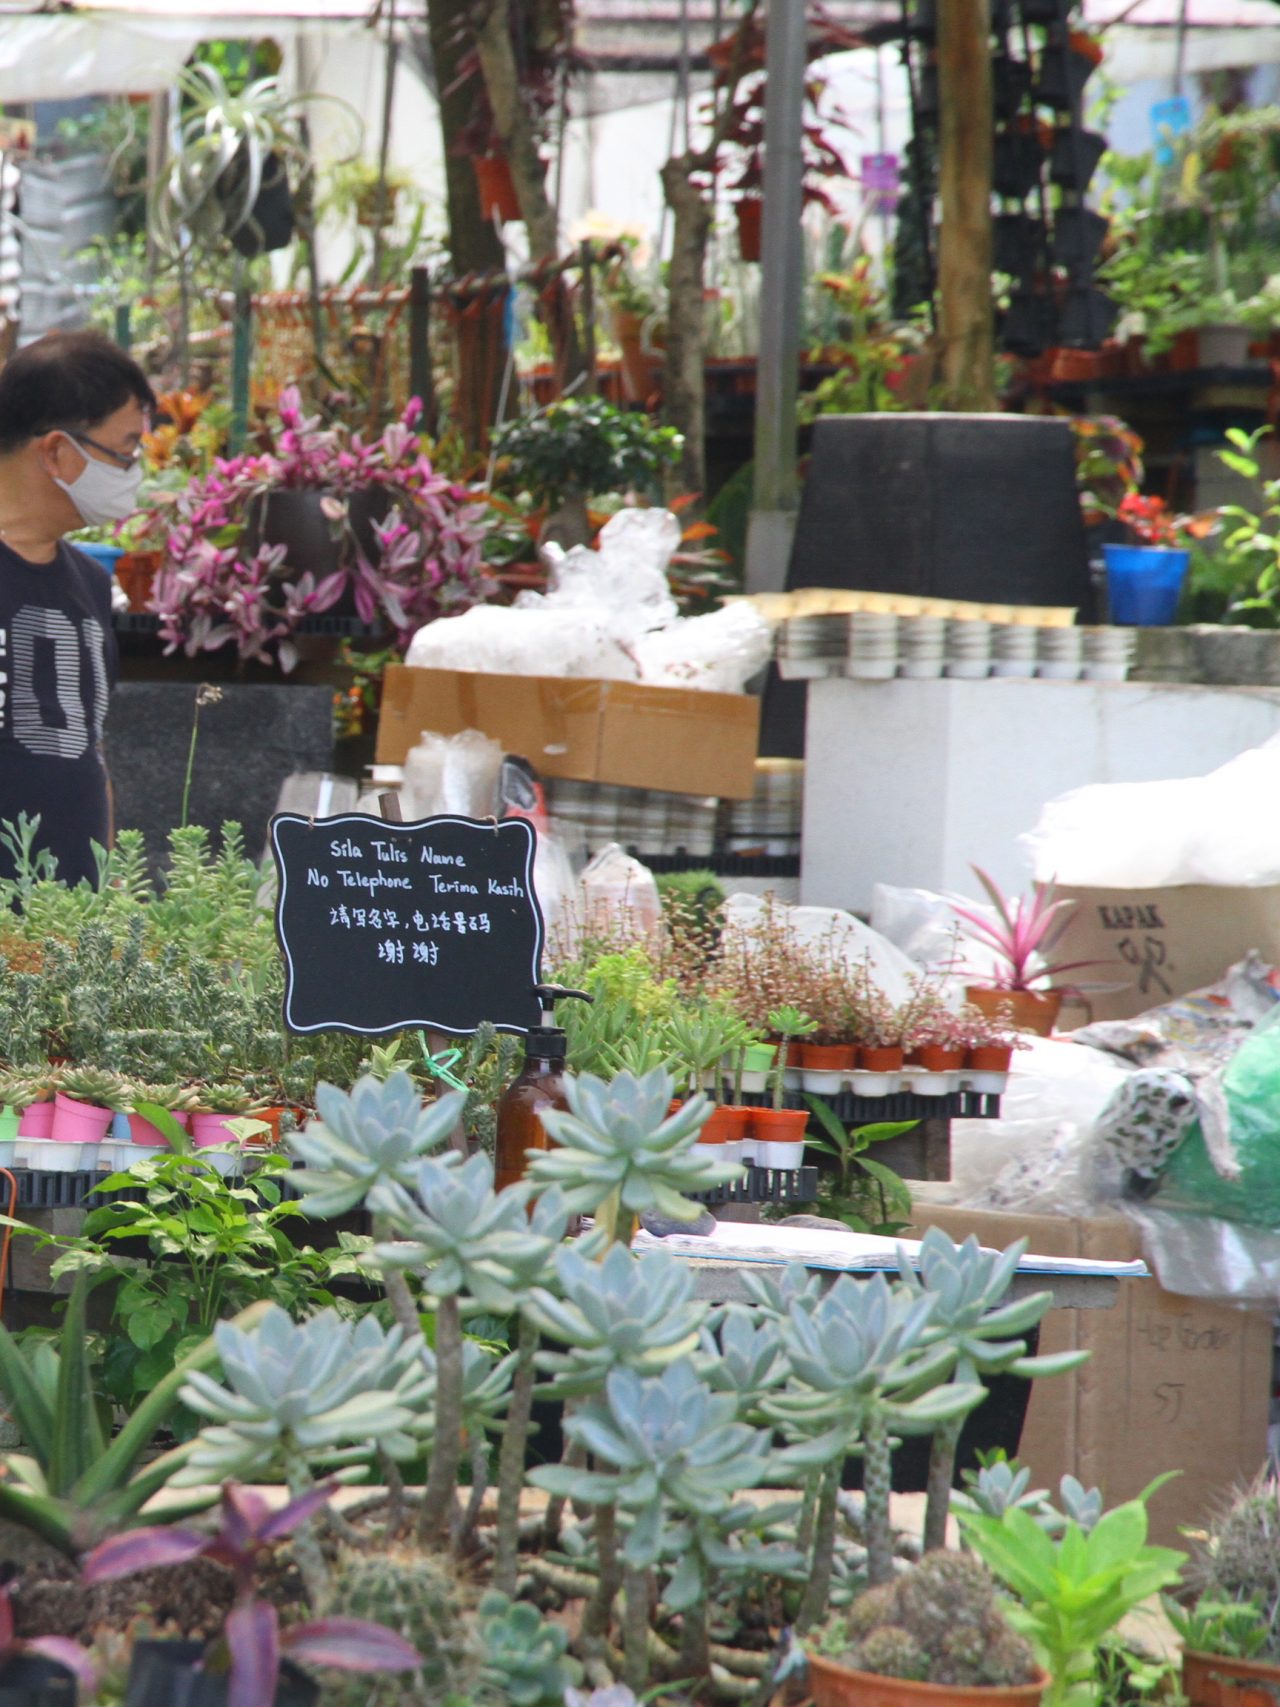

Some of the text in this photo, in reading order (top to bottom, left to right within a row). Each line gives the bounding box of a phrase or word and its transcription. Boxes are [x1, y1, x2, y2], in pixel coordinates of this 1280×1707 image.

[330, 838, 467, 867] Sila Tulis Name
[307, 868, 524, 898] No Telephone Terima Kasih
